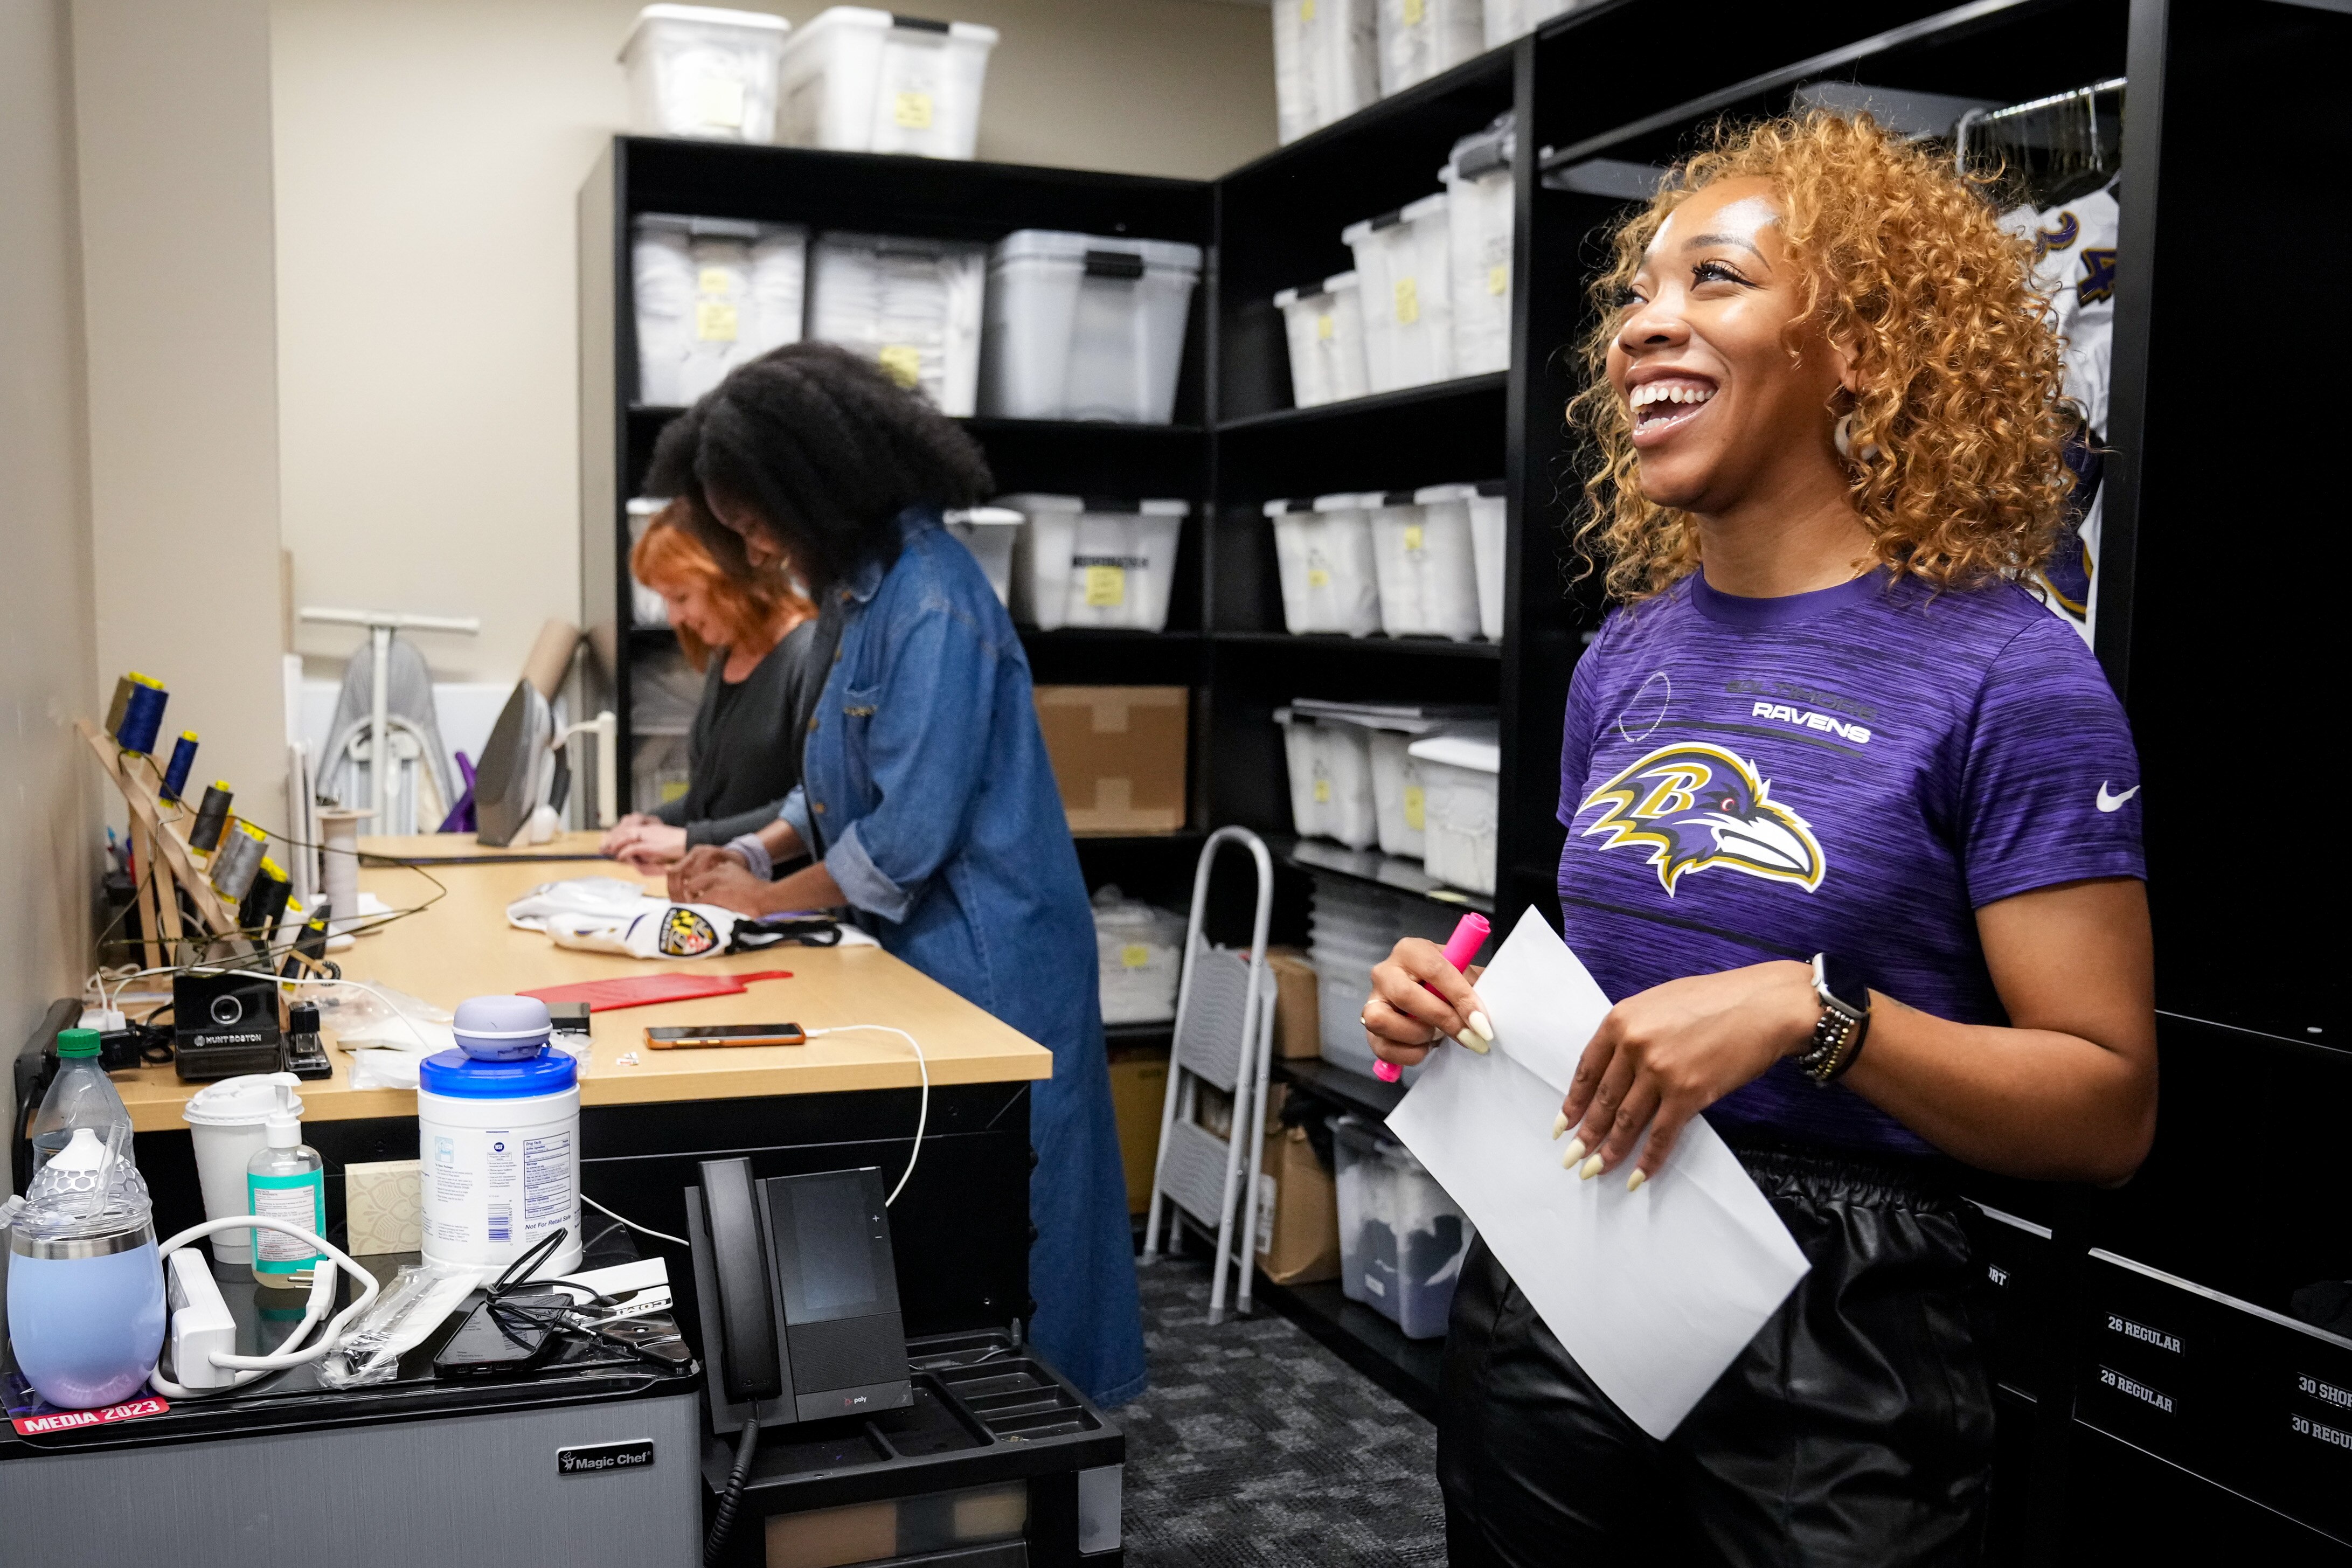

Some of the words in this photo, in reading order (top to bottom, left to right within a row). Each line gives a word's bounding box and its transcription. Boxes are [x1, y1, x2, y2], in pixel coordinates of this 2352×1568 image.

[1726, 680, 1878, 723] BALTIMORE
[1752, 702, 1871, 744] RAVENS
[1629, 762, 1712, 819] B
[548, 1217, 562, 1225] Retail
[2108, 1316, 2123, 1332] 26
[2125, 1322, 2181, 1353] REGULAR
[854, 1396, 867, 1404] poly
[2100, 1370, 2115, 1386] 28
[2117, 1377, 2173, 1413] REGULAR
[2299, 1377, 2316, 1394] 30
[24, 1411, 99, 1432] MEDIA
[101, 1400, 160, 1420] 2023
[2292, 1417, 2309, 1434] 30
[2312, 1423, 2352, 1450] REGU
[576, 1456, 614, 1469] Magic
[617, 1452, 647, 1465] Chef
